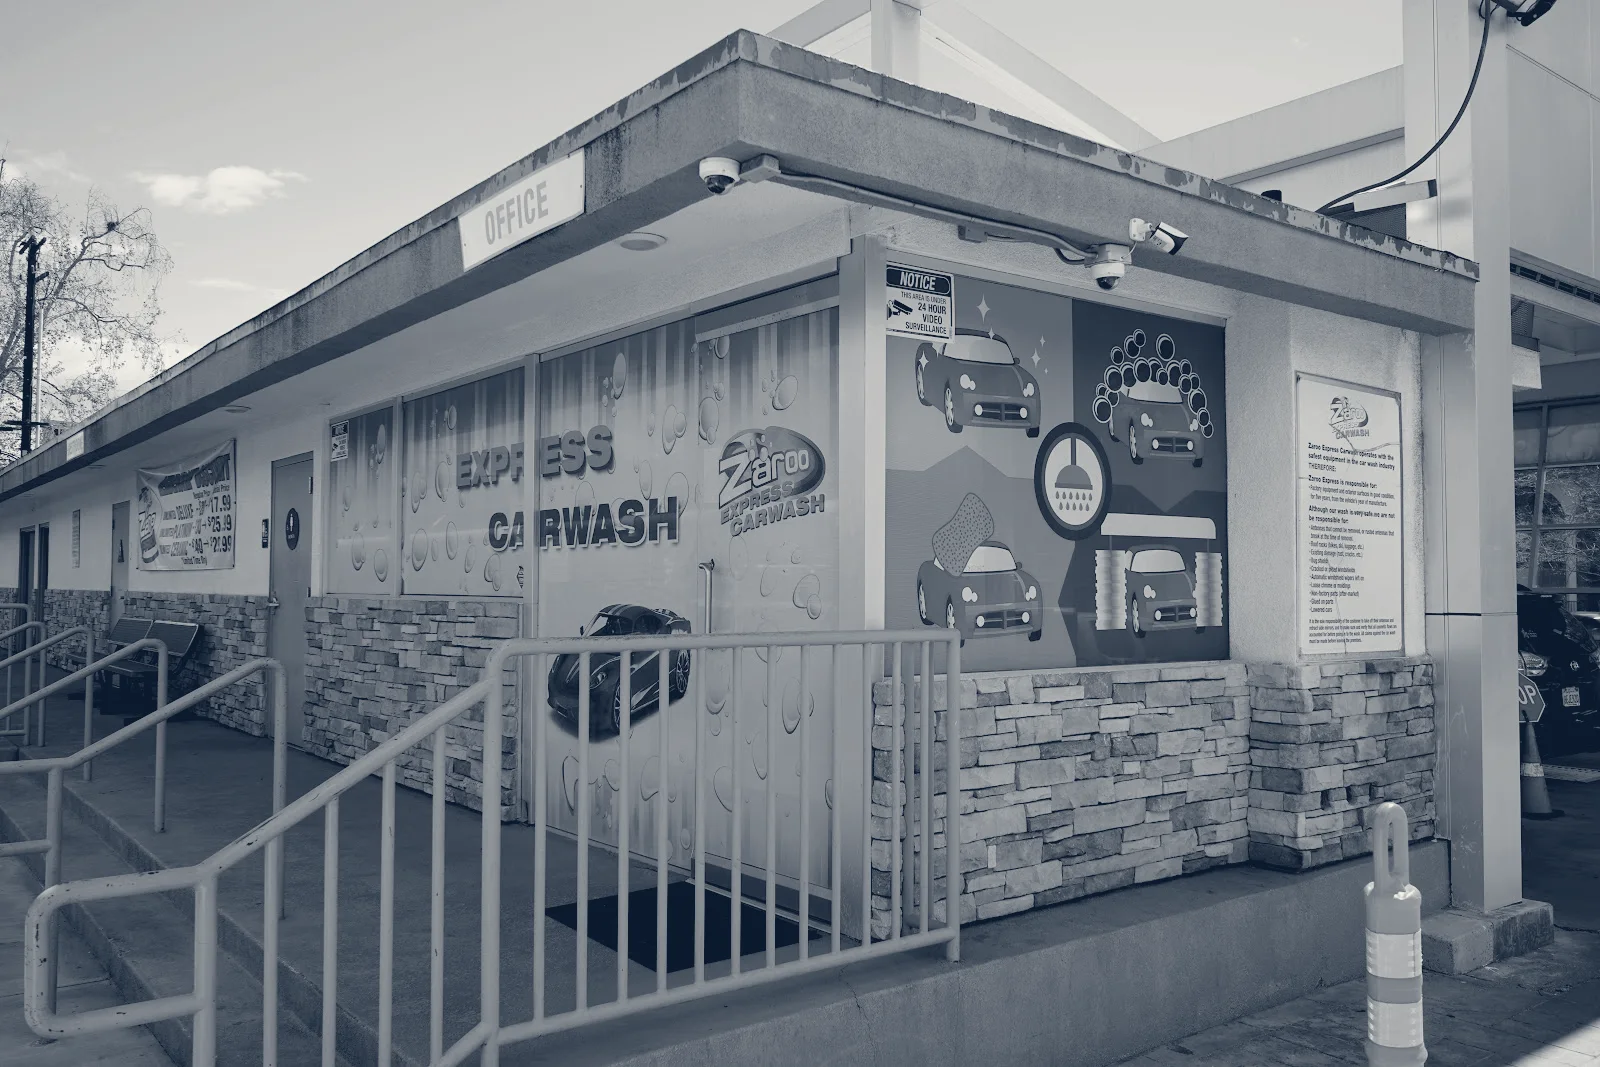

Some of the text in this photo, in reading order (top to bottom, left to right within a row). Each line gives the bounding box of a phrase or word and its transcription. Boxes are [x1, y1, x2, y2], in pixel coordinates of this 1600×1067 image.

[485, 180, 548, 245] OFFICE
[900, 272, 936, 290] NOTICE
[931, 296, 946, 304] UNDER
[918, 302, 946, 314] 24 HOUR
[923, 314, 942, 324] VIDEO
[906, 322, 946, 334] SURVEILLANCE
[1322, 444, 1339, 454] Express
[719, 448, 810, 510] Zaroo
[1322, 476, 1339, 486] Express
[720, 480, 794, 526] EXPRESS
[730, 493, 825, 537] CARWASH
[1518, 685, 1536, 704] OP
